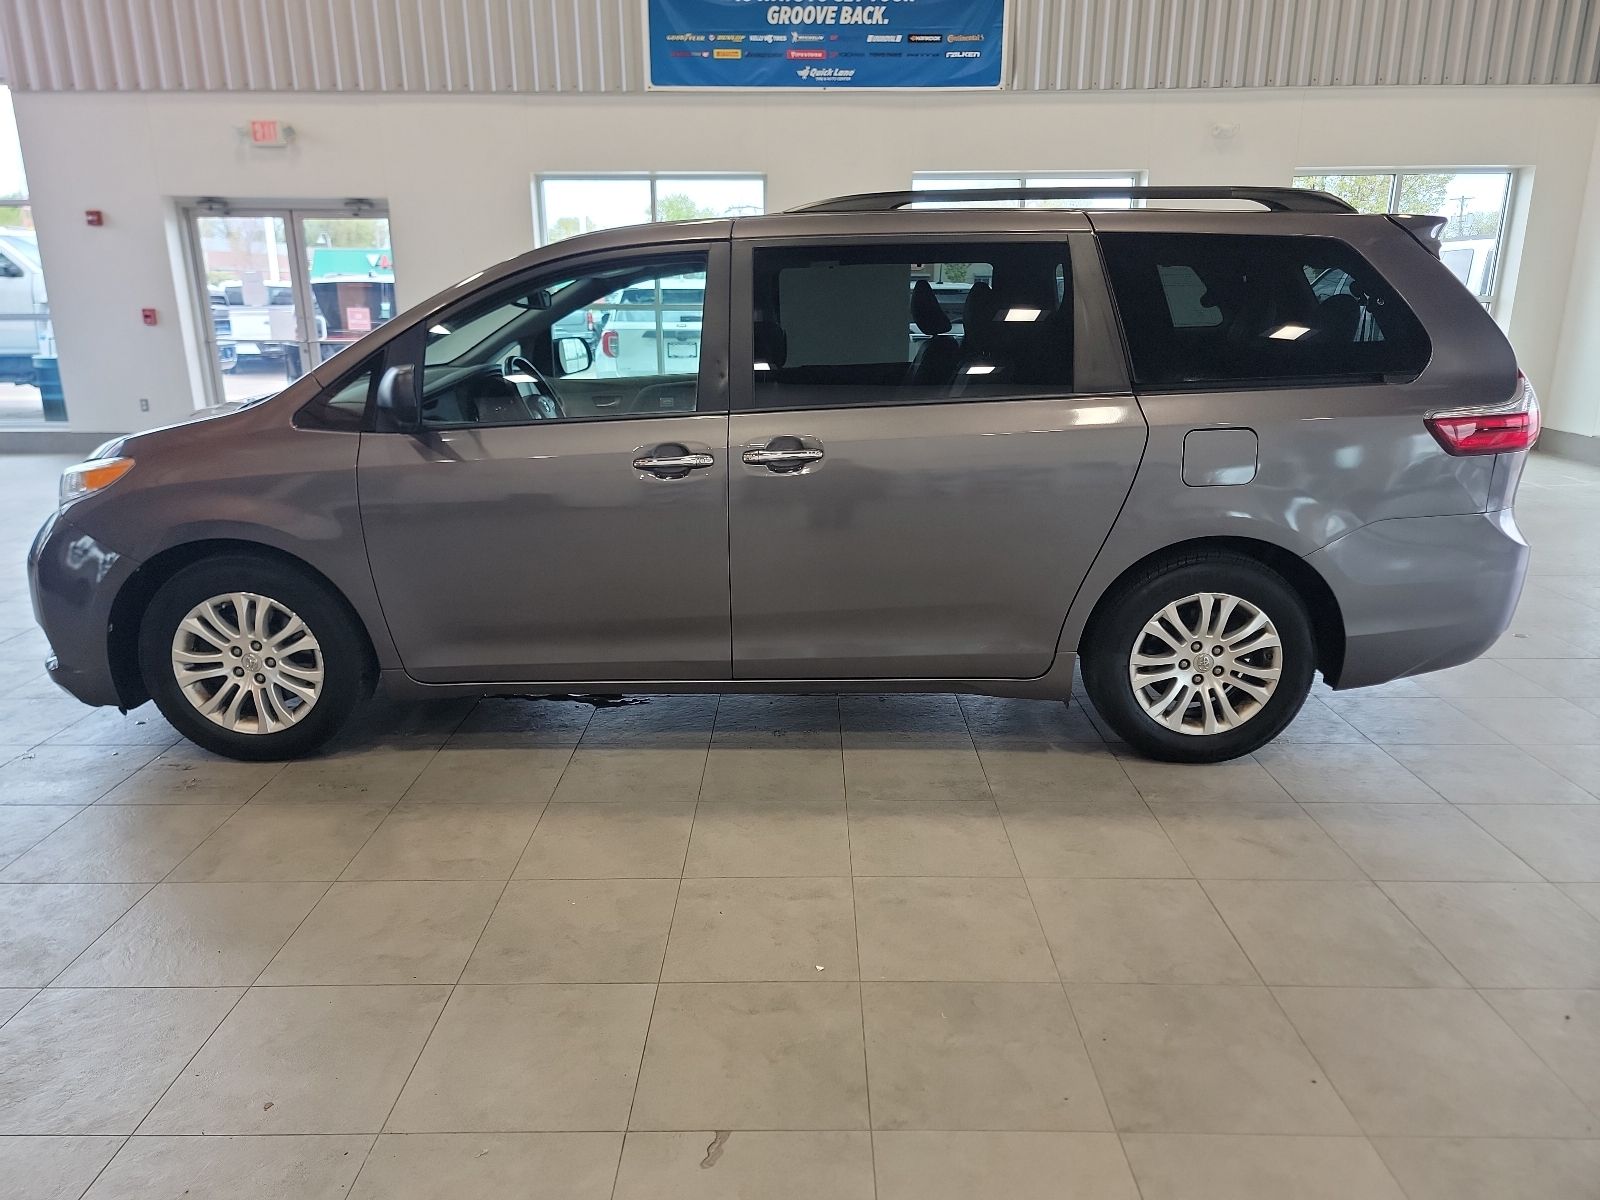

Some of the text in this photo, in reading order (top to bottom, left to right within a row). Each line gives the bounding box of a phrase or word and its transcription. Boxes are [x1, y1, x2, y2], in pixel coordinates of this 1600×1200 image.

[766, 5, 890, 25] GROOVE BACK.
[809, 67, 856, 78] Quick Lane
